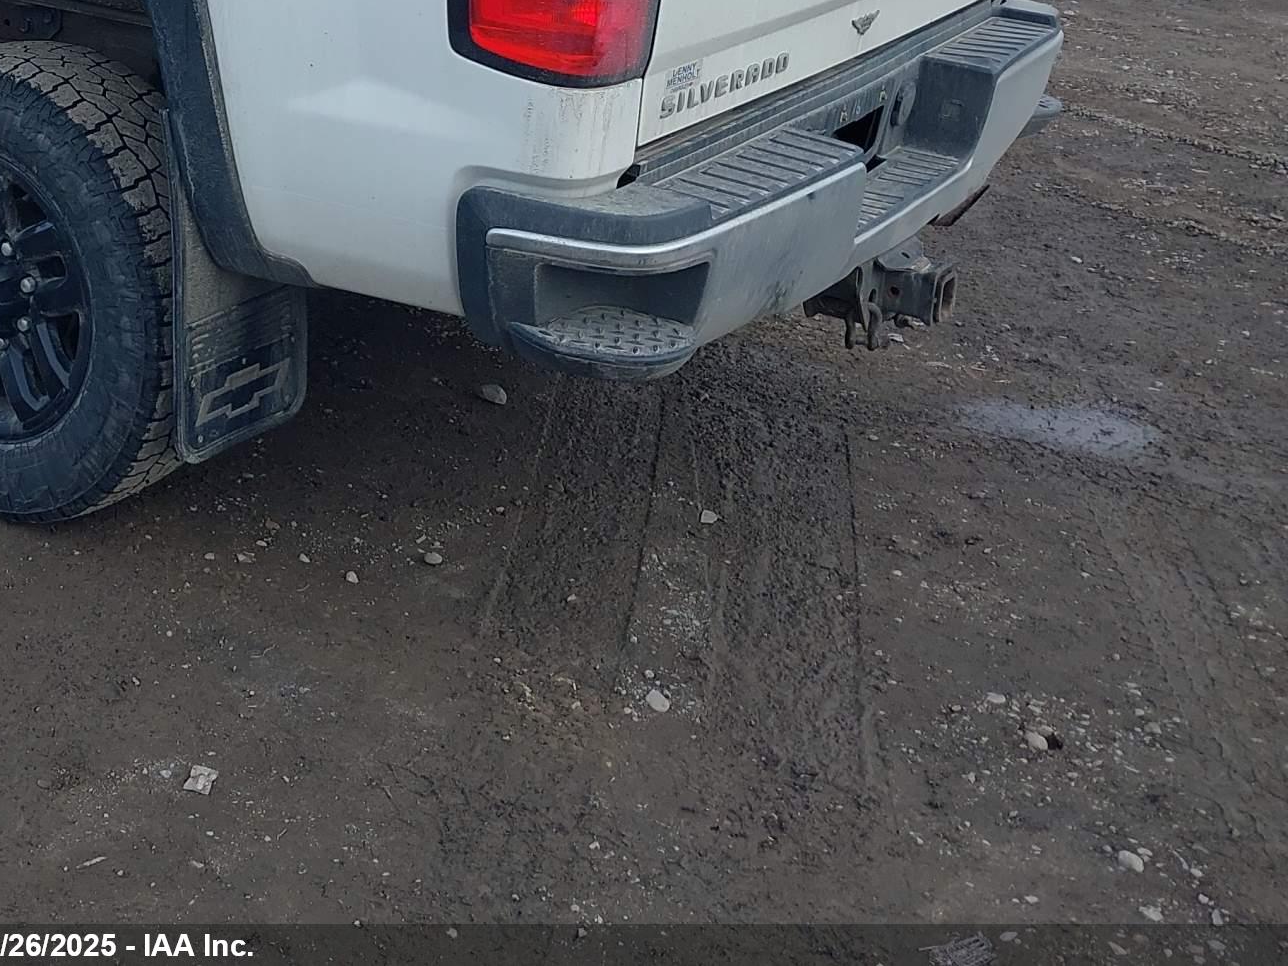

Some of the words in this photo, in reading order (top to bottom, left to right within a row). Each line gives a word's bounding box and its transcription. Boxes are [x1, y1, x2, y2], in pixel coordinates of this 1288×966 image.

[666, 68, 701, 87] MENHOLT
[672, 61, 698, 78] LENNY
[659, 51, 791, 120] SILVERADO
